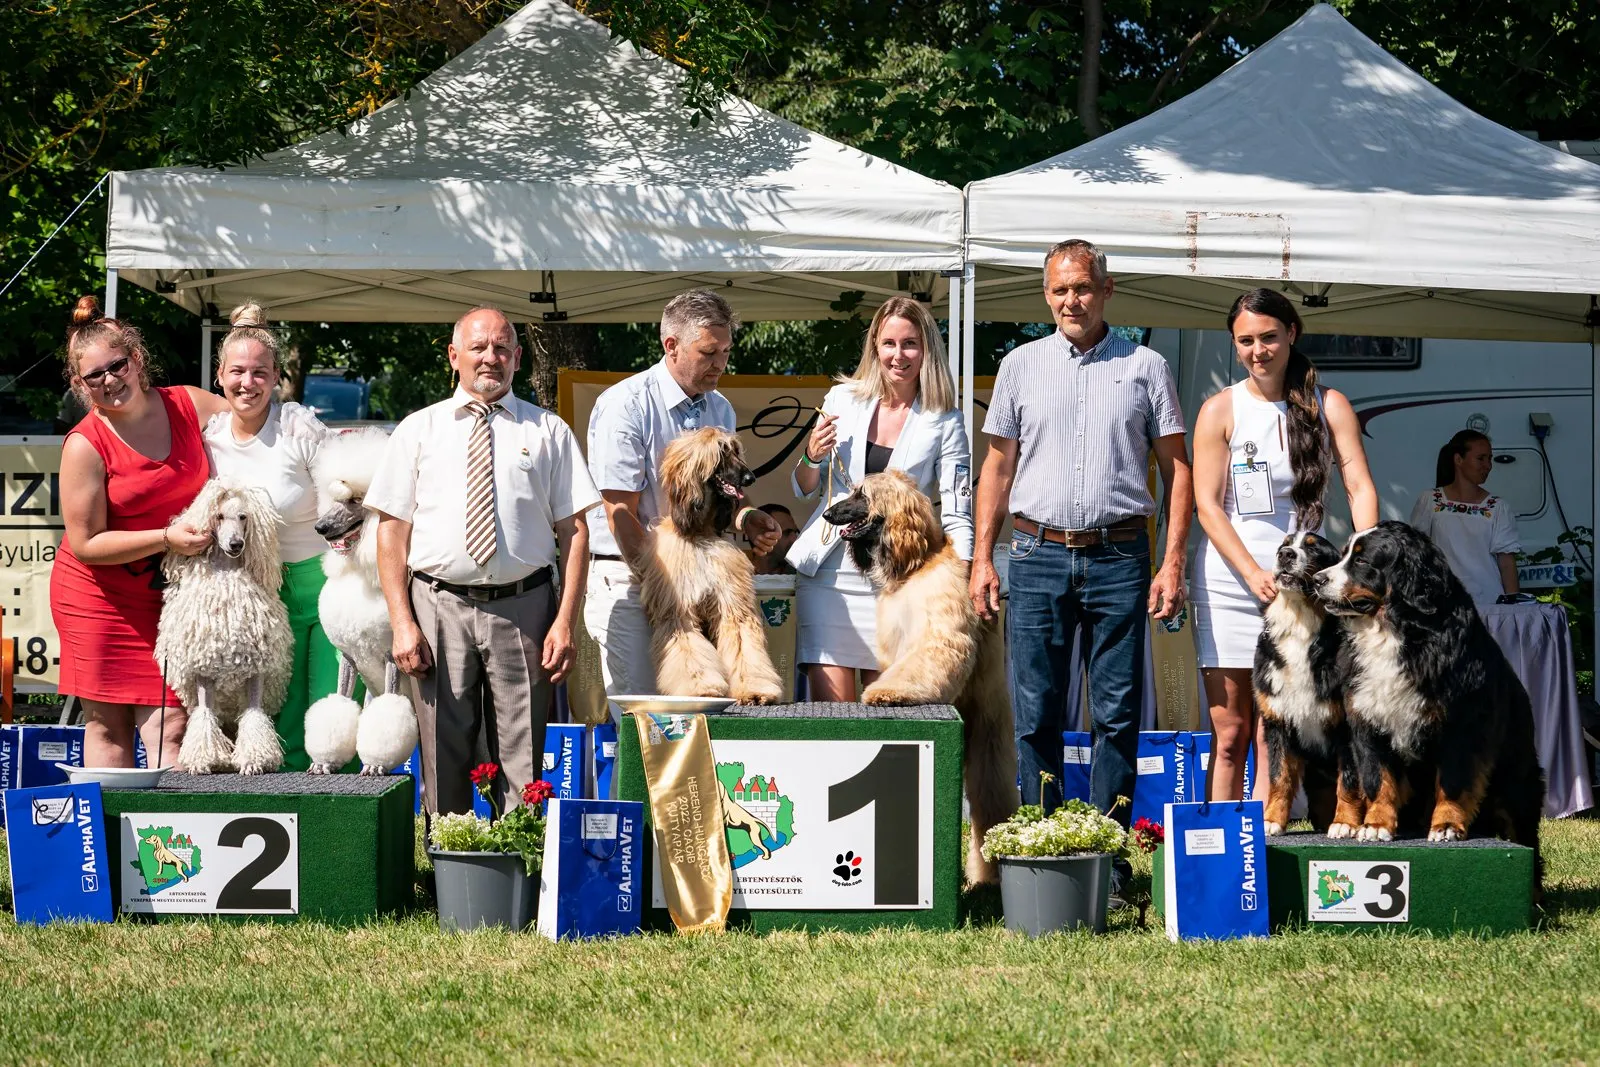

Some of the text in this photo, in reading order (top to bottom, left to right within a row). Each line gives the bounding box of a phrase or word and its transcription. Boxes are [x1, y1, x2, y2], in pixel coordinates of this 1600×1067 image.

[1241, 482, 1254, 498] 3
[0, 540, 56, 567] yula
[77, 798, 97, 873] ALPHAVET
[617, 816, 633, 893] ALPHAVET
[677, 795, 696, 864] 2022 CACIB
[828, 744, 919, 905] 1
[1239, 816, 1256, 892] ALPHAVET
[216, 817, 291, 909] 2
[1364, 864, 1406, 918] 3
